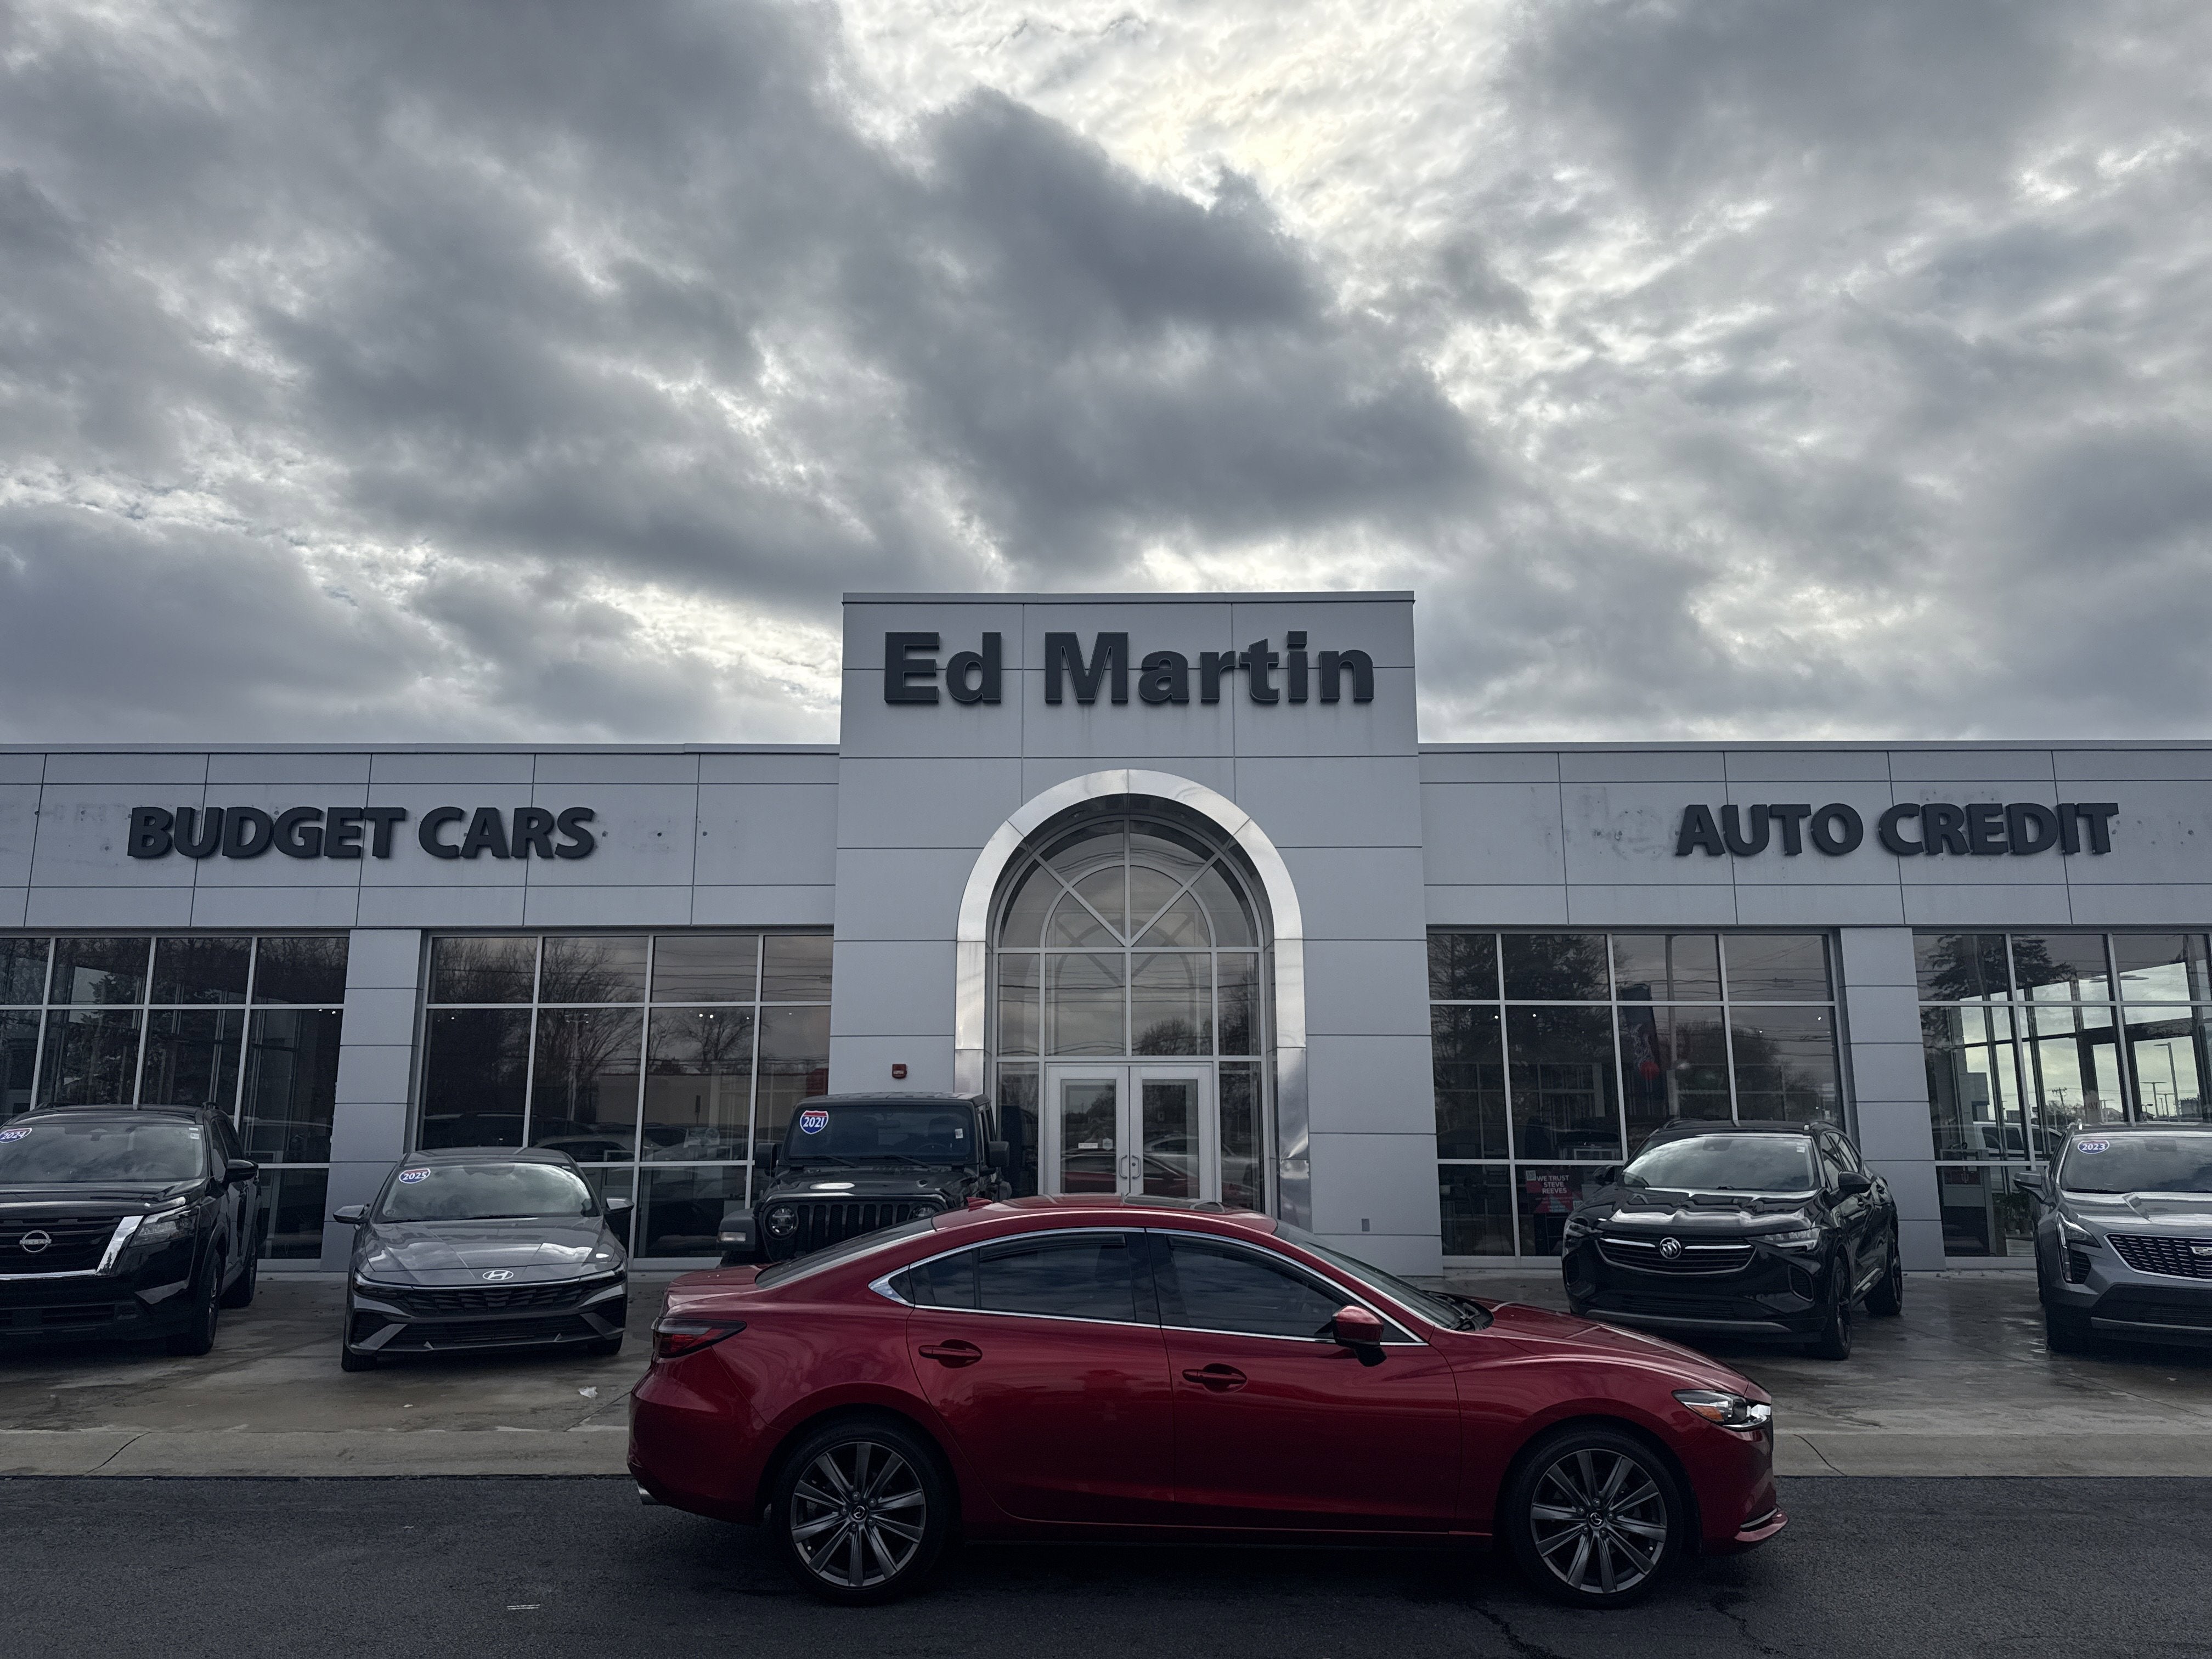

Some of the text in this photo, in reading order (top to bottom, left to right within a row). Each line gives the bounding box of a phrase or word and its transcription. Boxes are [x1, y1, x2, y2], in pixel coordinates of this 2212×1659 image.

[884, 630, 1375, 704] Ed Martin
[127, 806, 595, 859] BUDGET CARS
[1675, 803, 2119, 856] AUTO CREDIT
[0, 1131, 27, 1140] 2024
[803, 1116, 825, 1127] 2021
[402, 1171, 427, 1181] 2025
